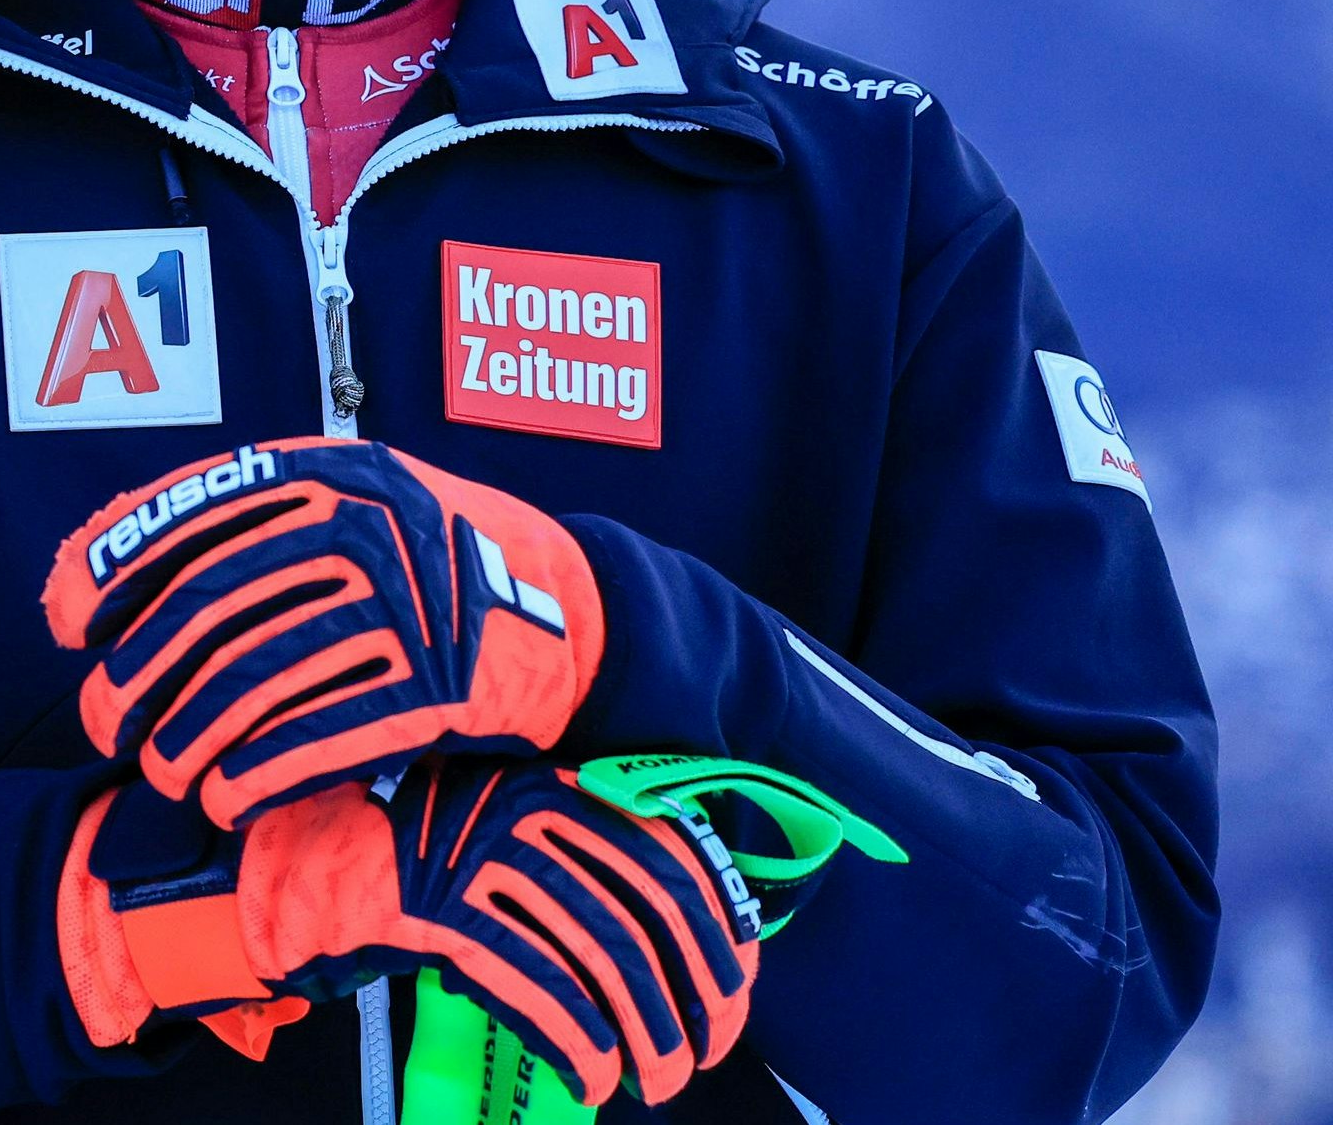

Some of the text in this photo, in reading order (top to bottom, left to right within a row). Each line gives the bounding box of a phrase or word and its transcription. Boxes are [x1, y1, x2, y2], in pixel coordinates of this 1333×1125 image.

[35, 249, 191, 407] A1
[458, 264, 647, 344] Kronen
[460, 334, 648, 422] Zeitung
[88, 446, 277, 581] reusch
[677, 809, 762, 934] usch
